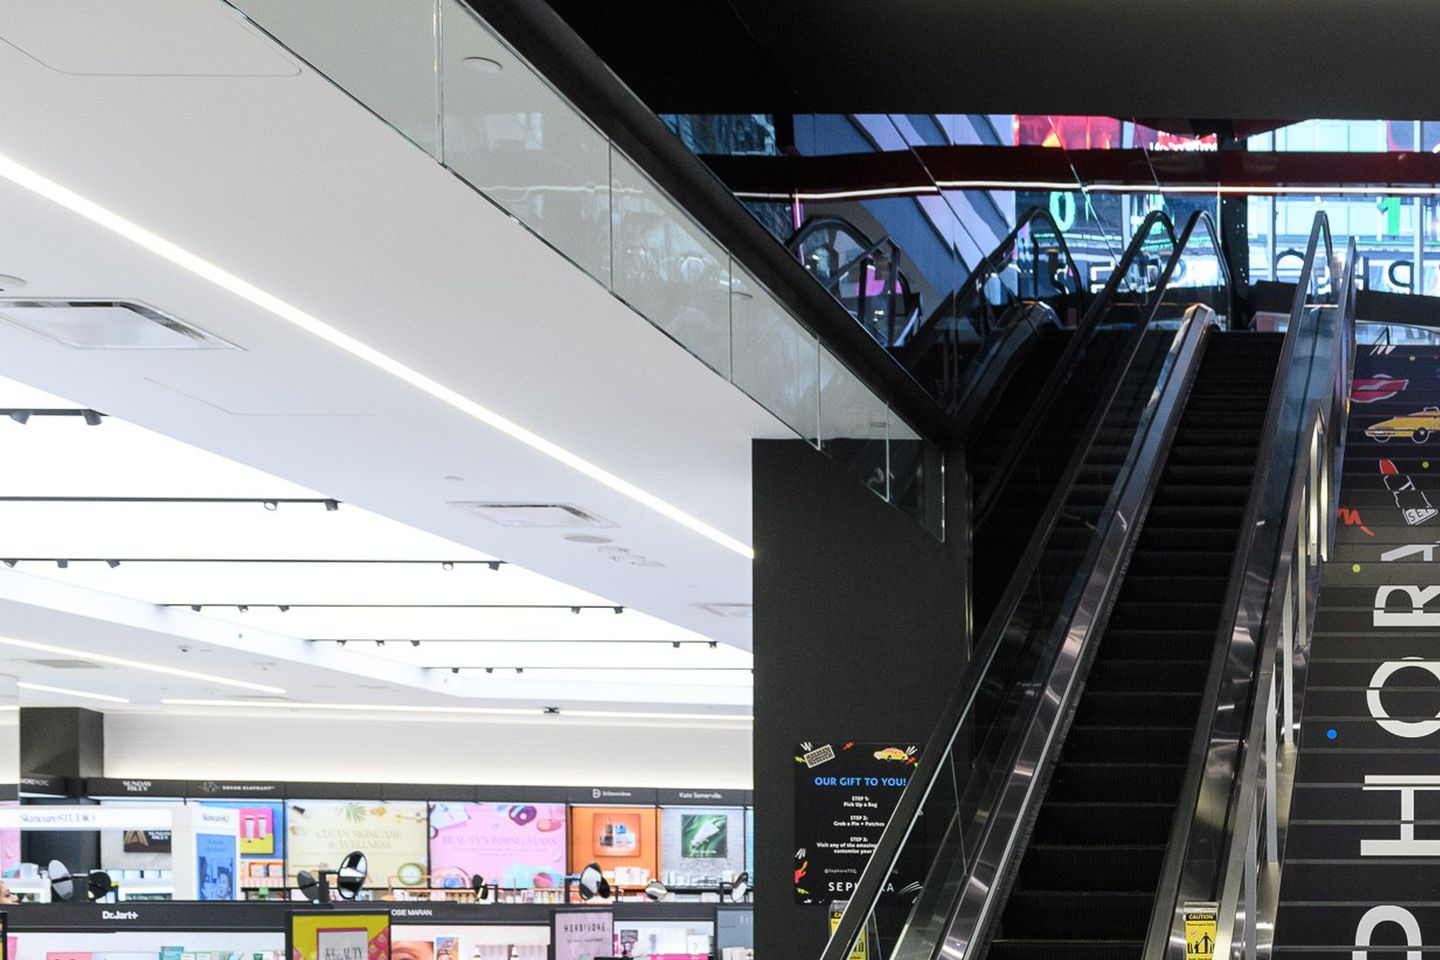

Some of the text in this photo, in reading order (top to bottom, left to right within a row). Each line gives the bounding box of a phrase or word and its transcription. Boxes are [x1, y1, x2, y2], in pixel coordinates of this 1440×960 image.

[814, 777, 907, 787] OUR GIFT TO YOU!
[102, 910, 138, 920] Dr.Jart+
